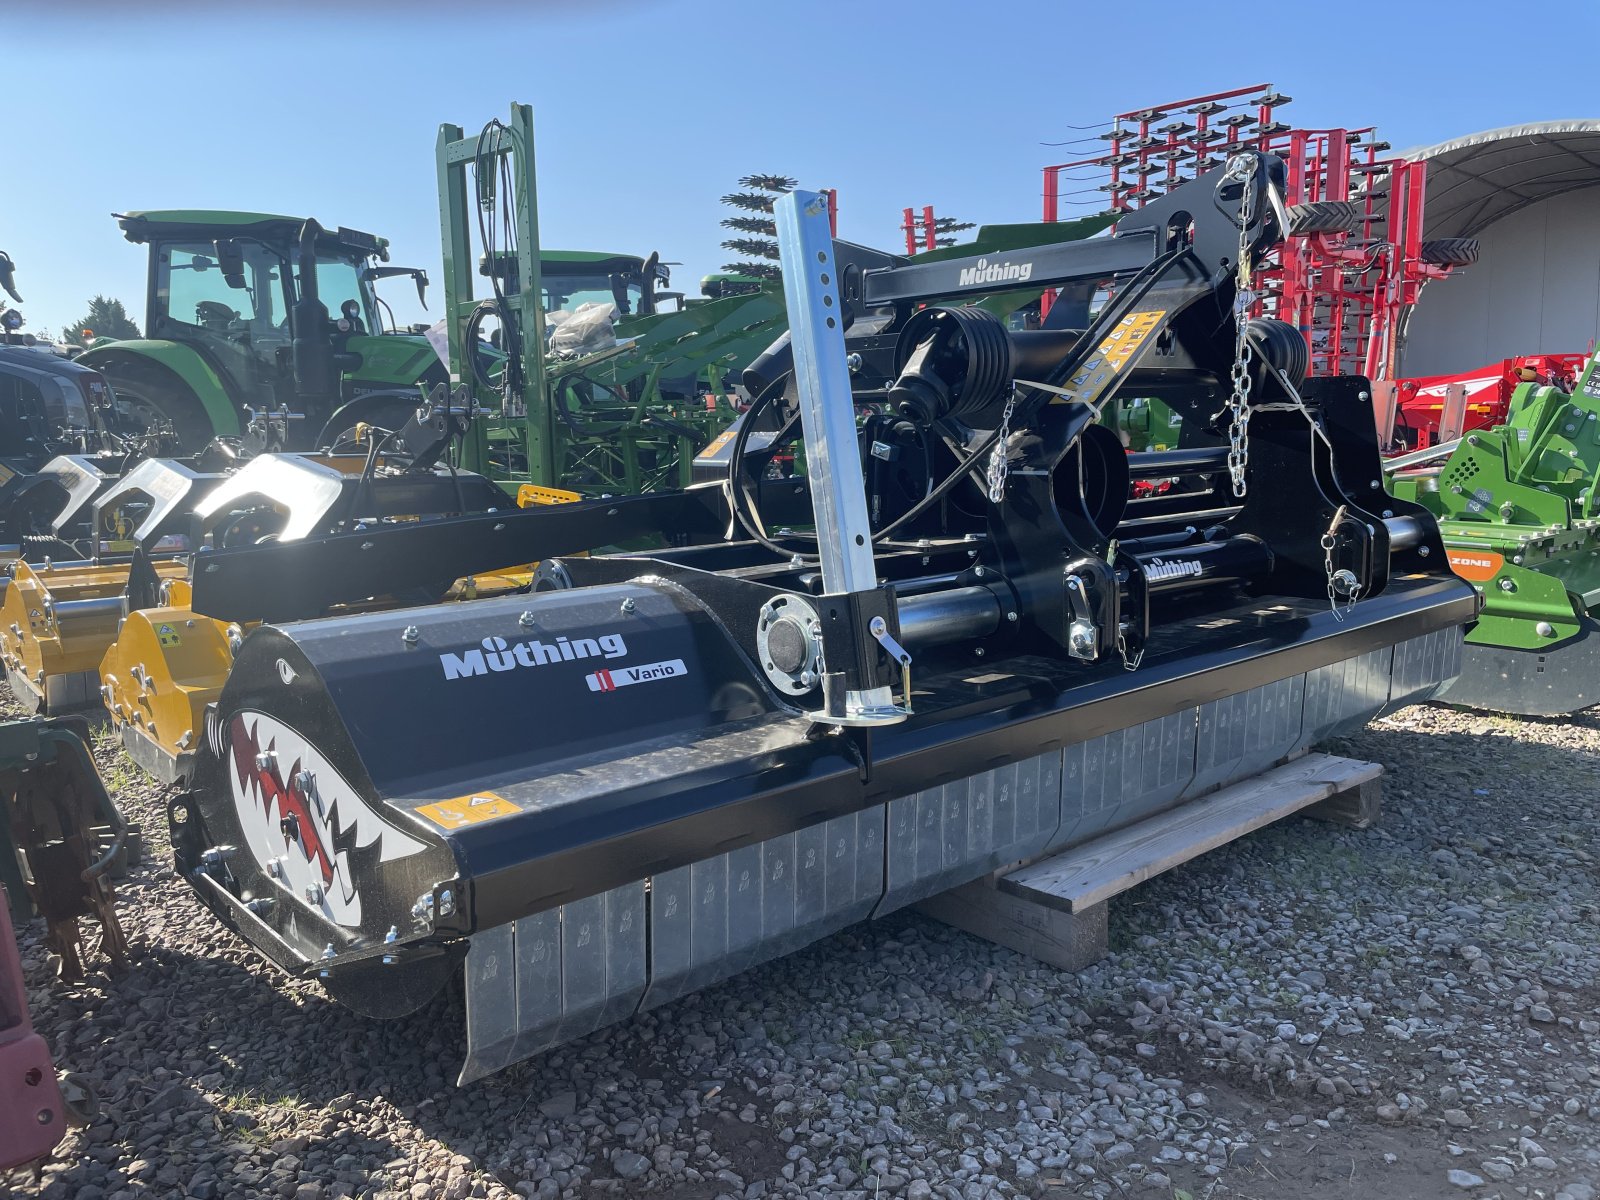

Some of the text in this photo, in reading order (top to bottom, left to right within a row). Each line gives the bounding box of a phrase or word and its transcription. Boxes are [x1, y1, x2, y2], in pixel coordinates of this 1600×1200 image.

[959, 258, 1033, 286] Müthing
[1143, 557, 1203, 581] Müthing
[1450, 557, 1492, 568] ZONE
[439, 633, 628, 680] Müthing
[627, 664, 675, 682] Vario
